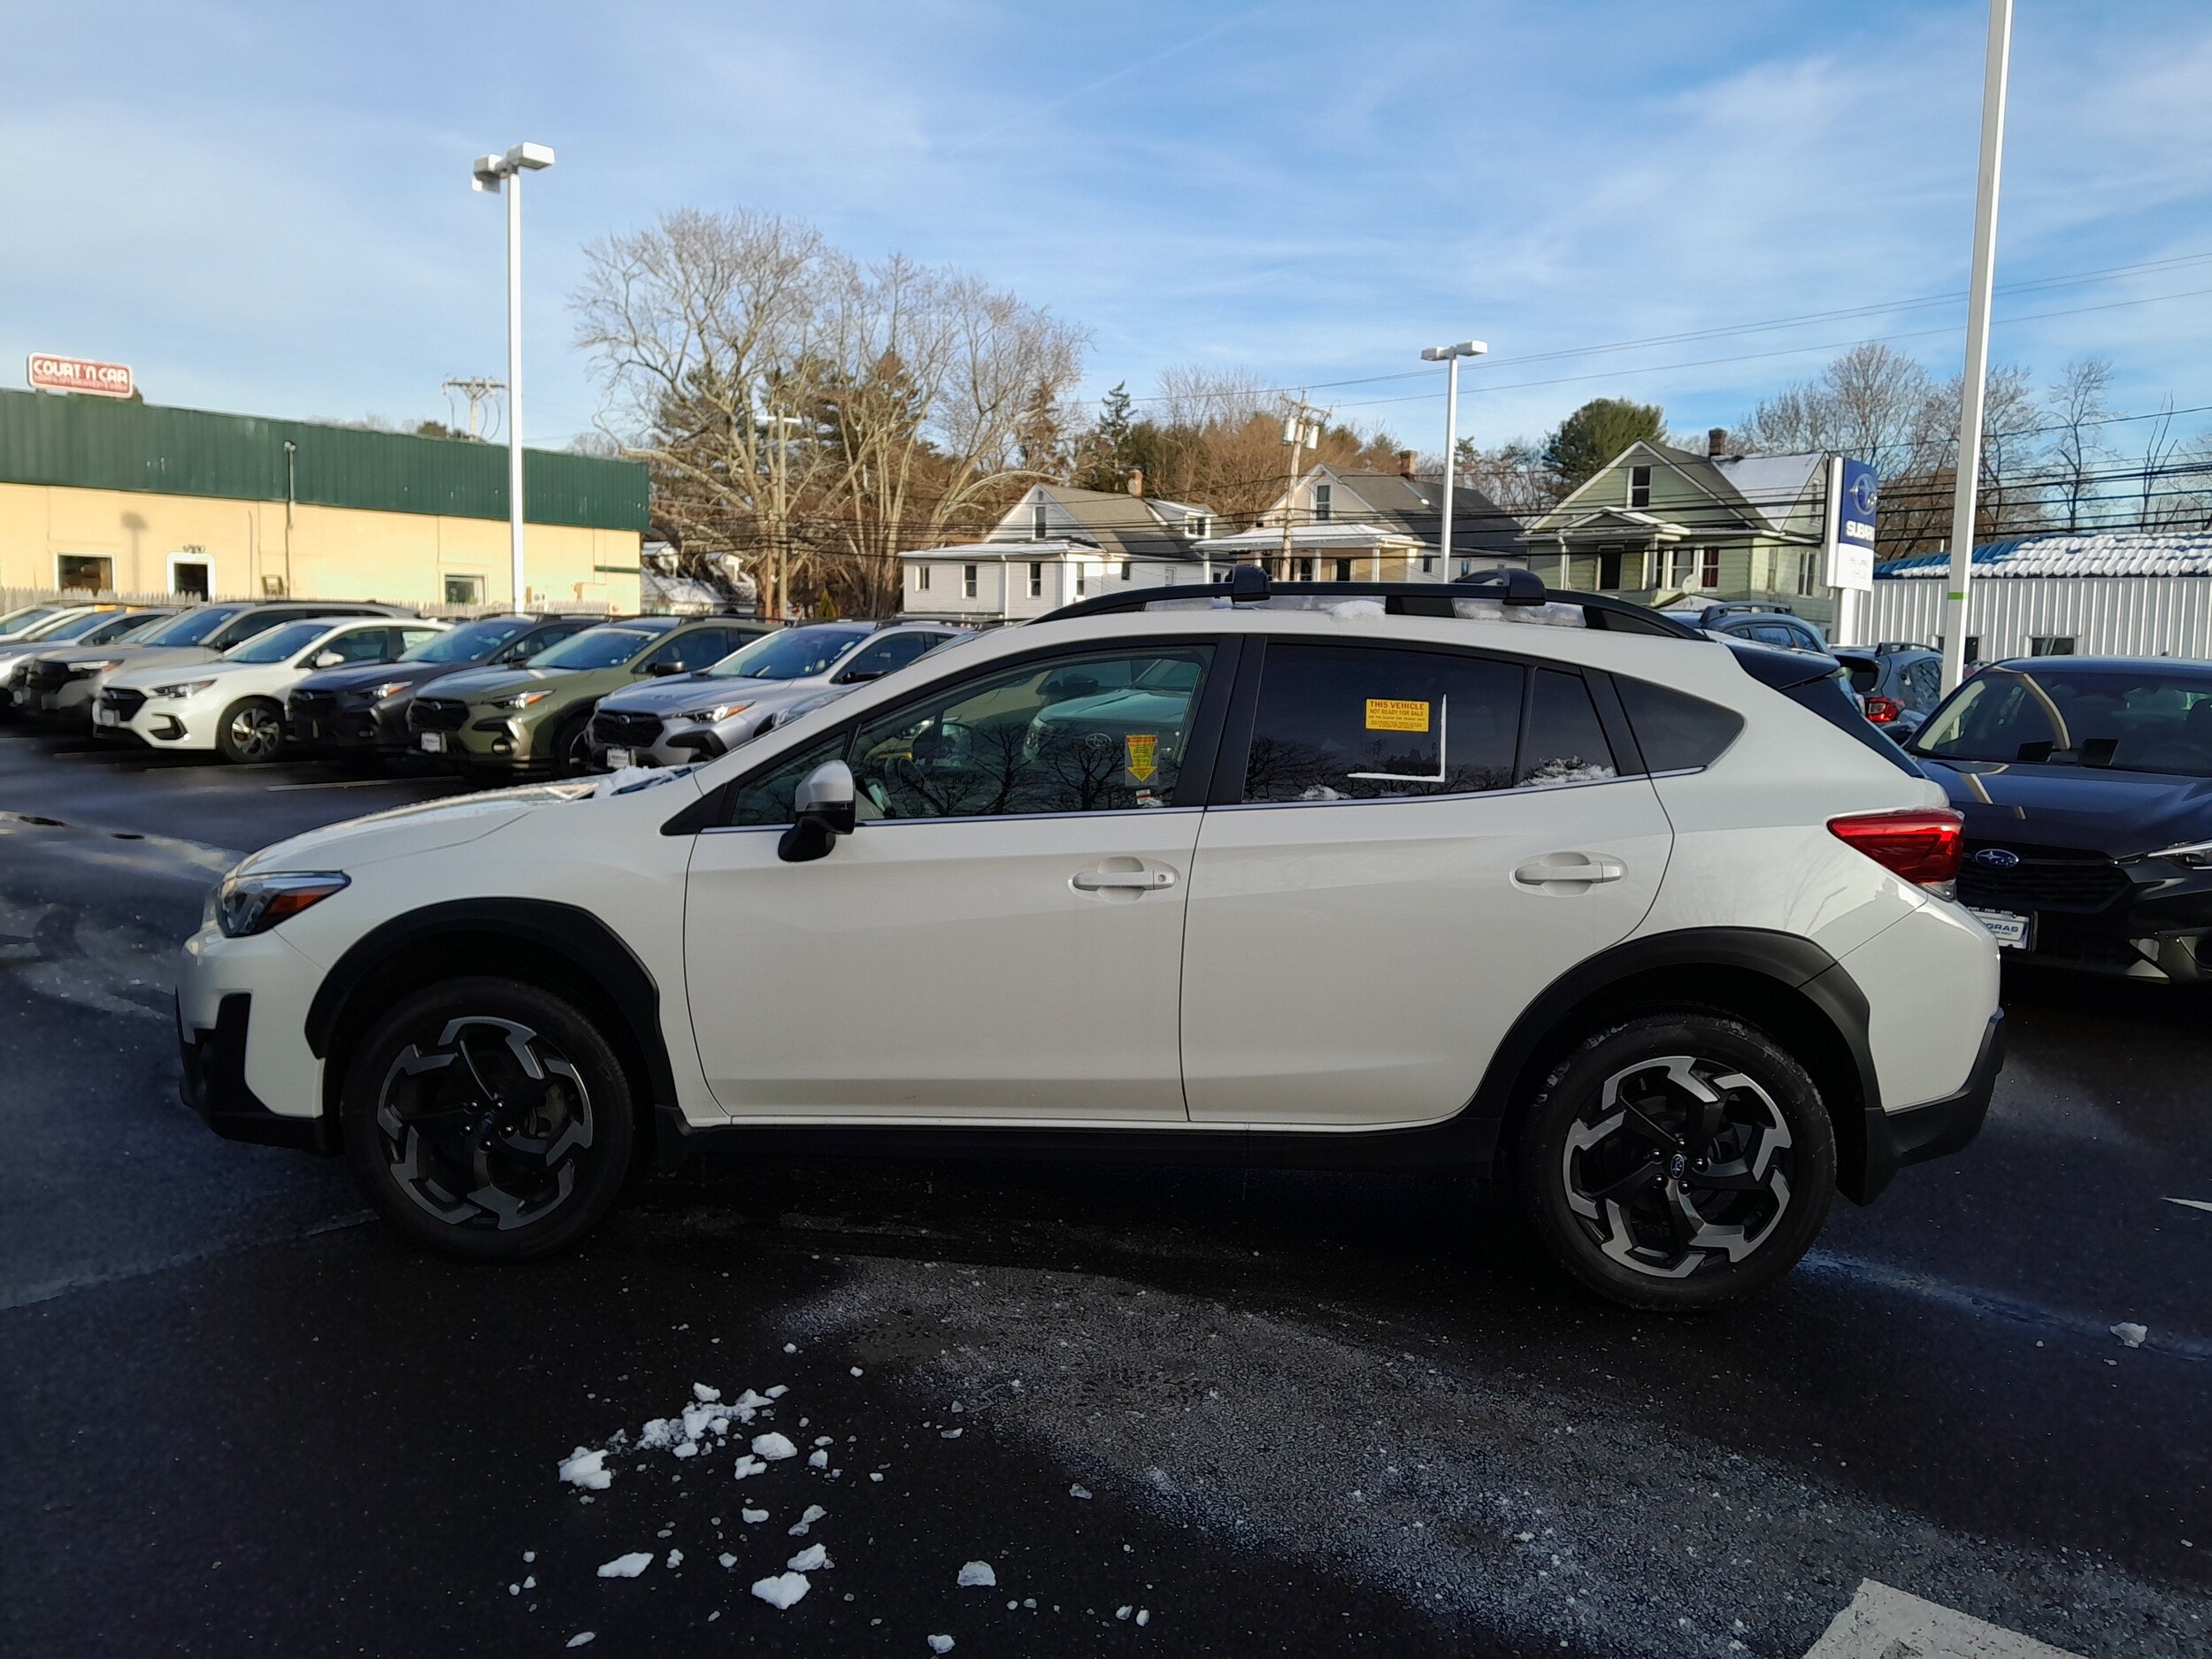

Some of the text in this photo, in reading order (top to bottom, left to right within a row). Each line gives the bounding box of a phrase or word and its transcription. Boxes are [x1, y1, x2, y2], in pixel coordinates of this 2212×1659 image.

[34, 359, 81, 381] COURT
[98, 367, 127, 383] CAR
[1390, 702, 1425, 710] VEHICLE
